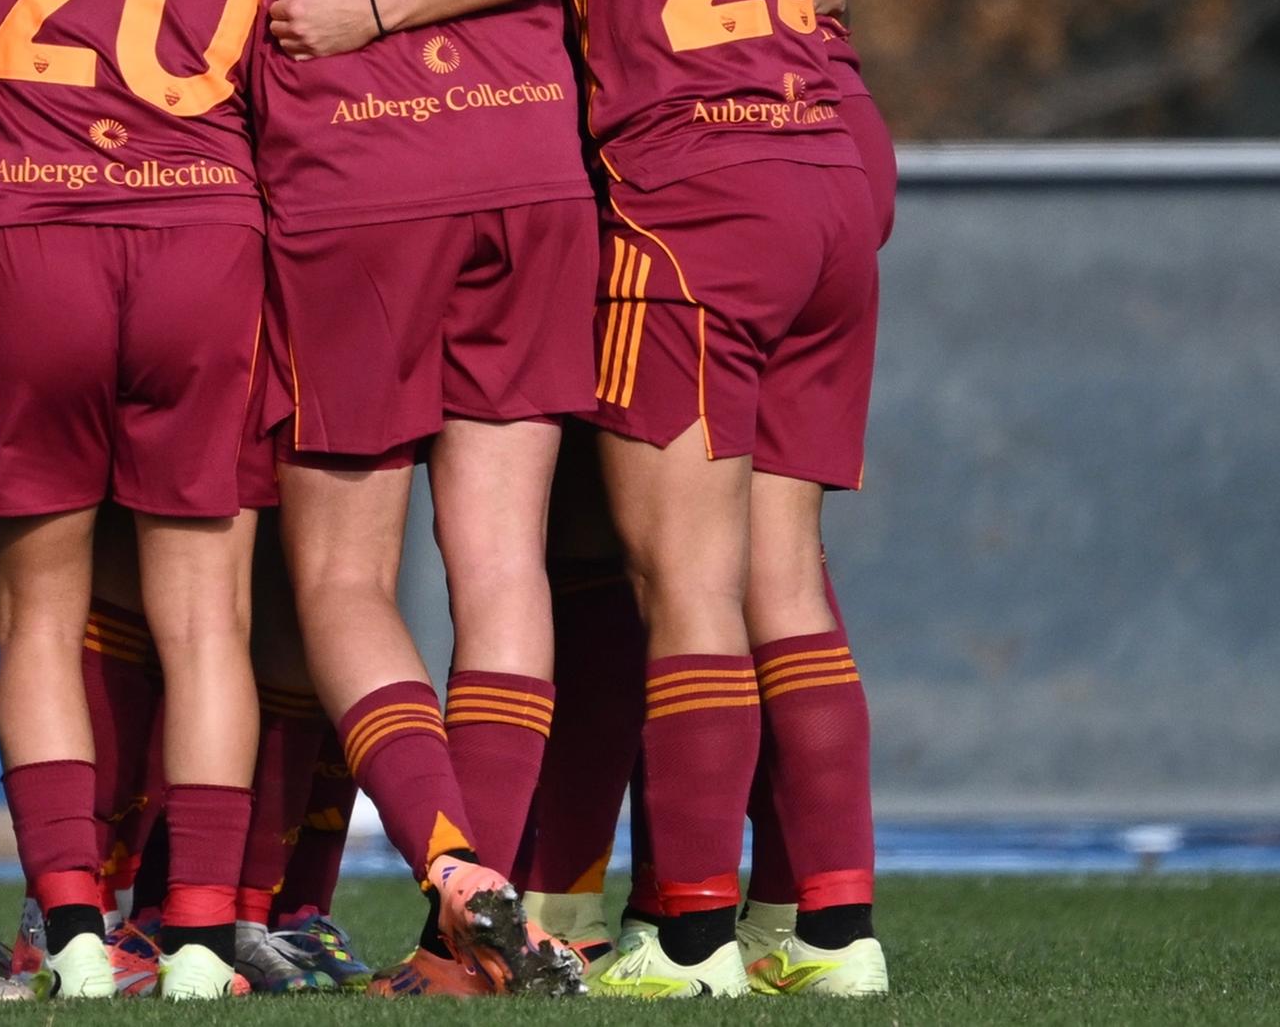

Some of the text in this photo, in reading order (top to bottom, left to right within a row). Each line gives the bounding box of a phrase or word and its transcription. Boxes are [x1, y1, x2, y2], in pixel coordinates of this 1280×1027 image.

[330, 81, 565, 125] Auberge Collection
[692, 98, 791, 129] Auberge
[104, 160, 239, 188] Collection
